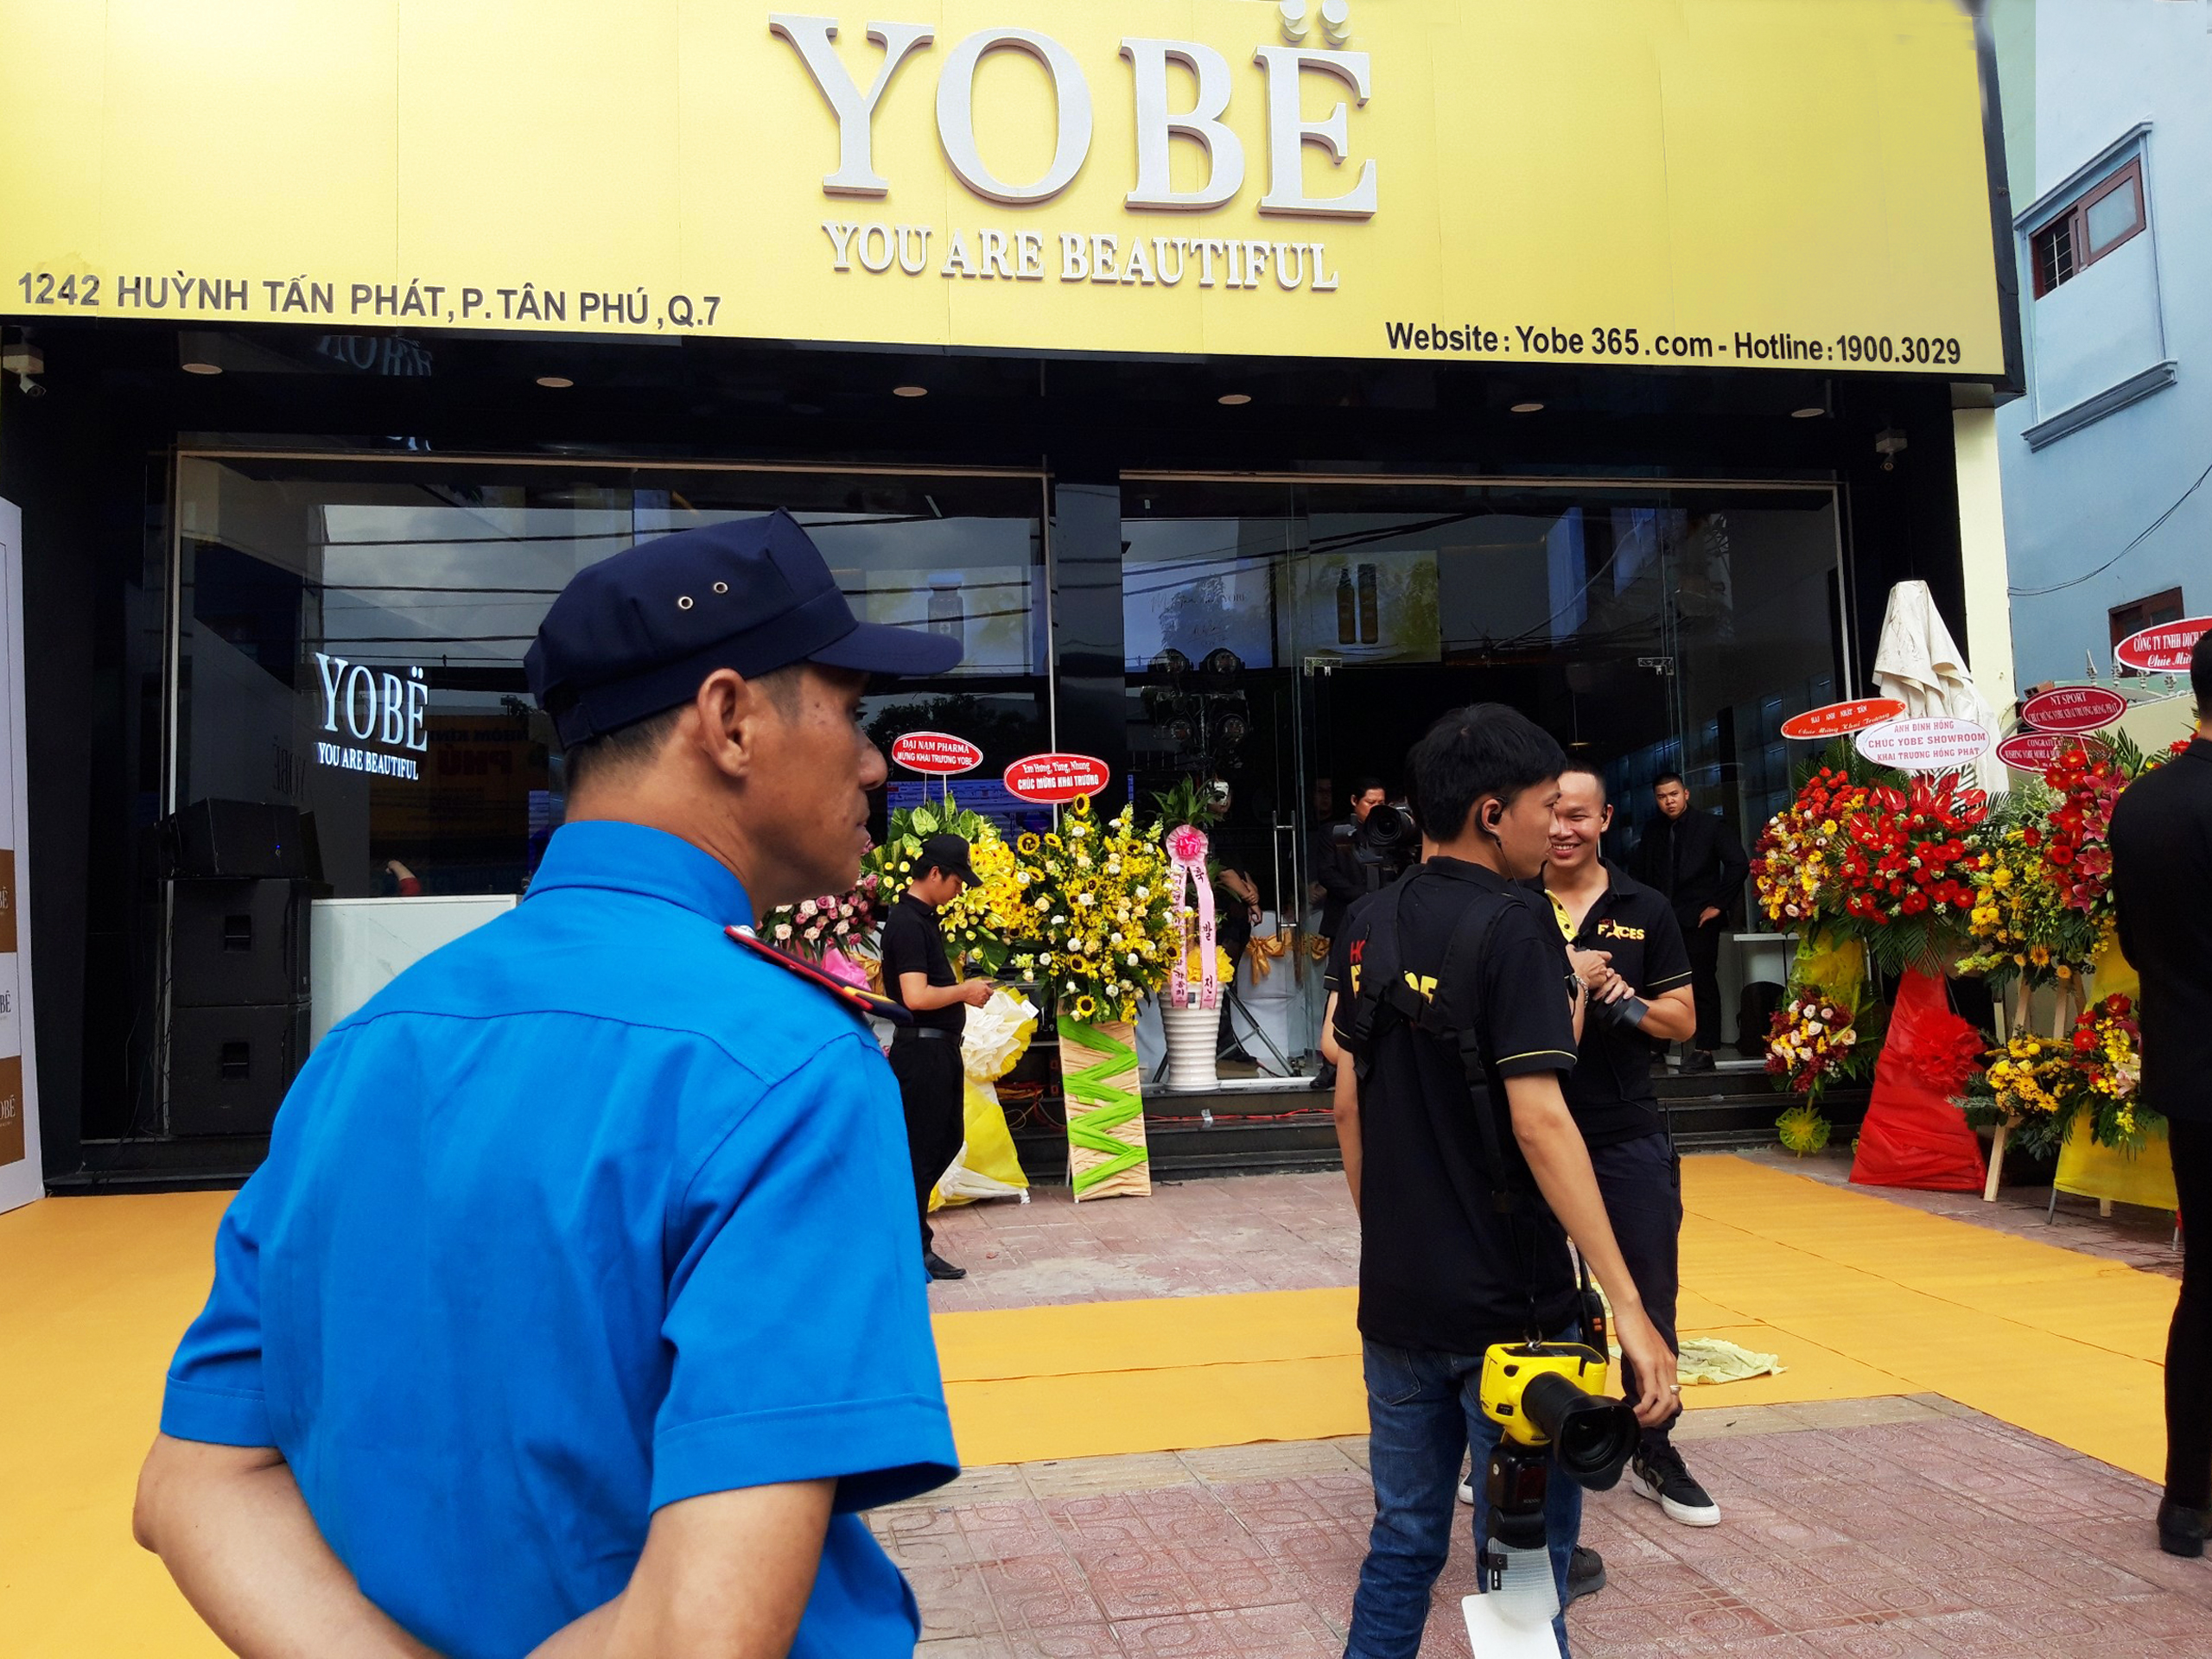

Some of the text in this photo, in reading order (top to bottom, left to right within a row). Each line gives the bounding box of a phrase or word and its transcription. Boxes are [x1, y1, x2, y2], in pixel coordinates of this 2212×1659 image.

[822, 221, 1338, 291] YOU ARE BEAUTIFUL
[18, 272, 99, 306] 1242
[118, 270, 248, 311] HUỲNH
[263, 275, 334, 314] TẤN
[1836, 334, 1961, 365] 1900.3029
[2133, 633, 2152, 652] CÔNG
[2152, 635, 2161, 651] TY
[2163, 633, 2181, 650] TNHH
[2148, 654, 2171, 667] Chúc
[2050, 692, 2087, 706] NT SPORT
[1894, 723, 1910, 733] ANH
[918, 741, 935, 751] NAM
[937, 742, 969, 753] PHARMA
[1868, 733, 1986, 748] CHÚC YOBE SHOWROOM
[318, 742, 419, 780] YOU ARE BEAUTIFUL
[916, 753, 931, 762] KHAI
[957, 756, 973, 766] YOBE
[1878, 753, 1896, 761] KHAI
[1022, 764, 1034, 773] Em
[1017, 777, 1035, 790] CHÚC
[1058, 776, 1073, 787] KHAI
